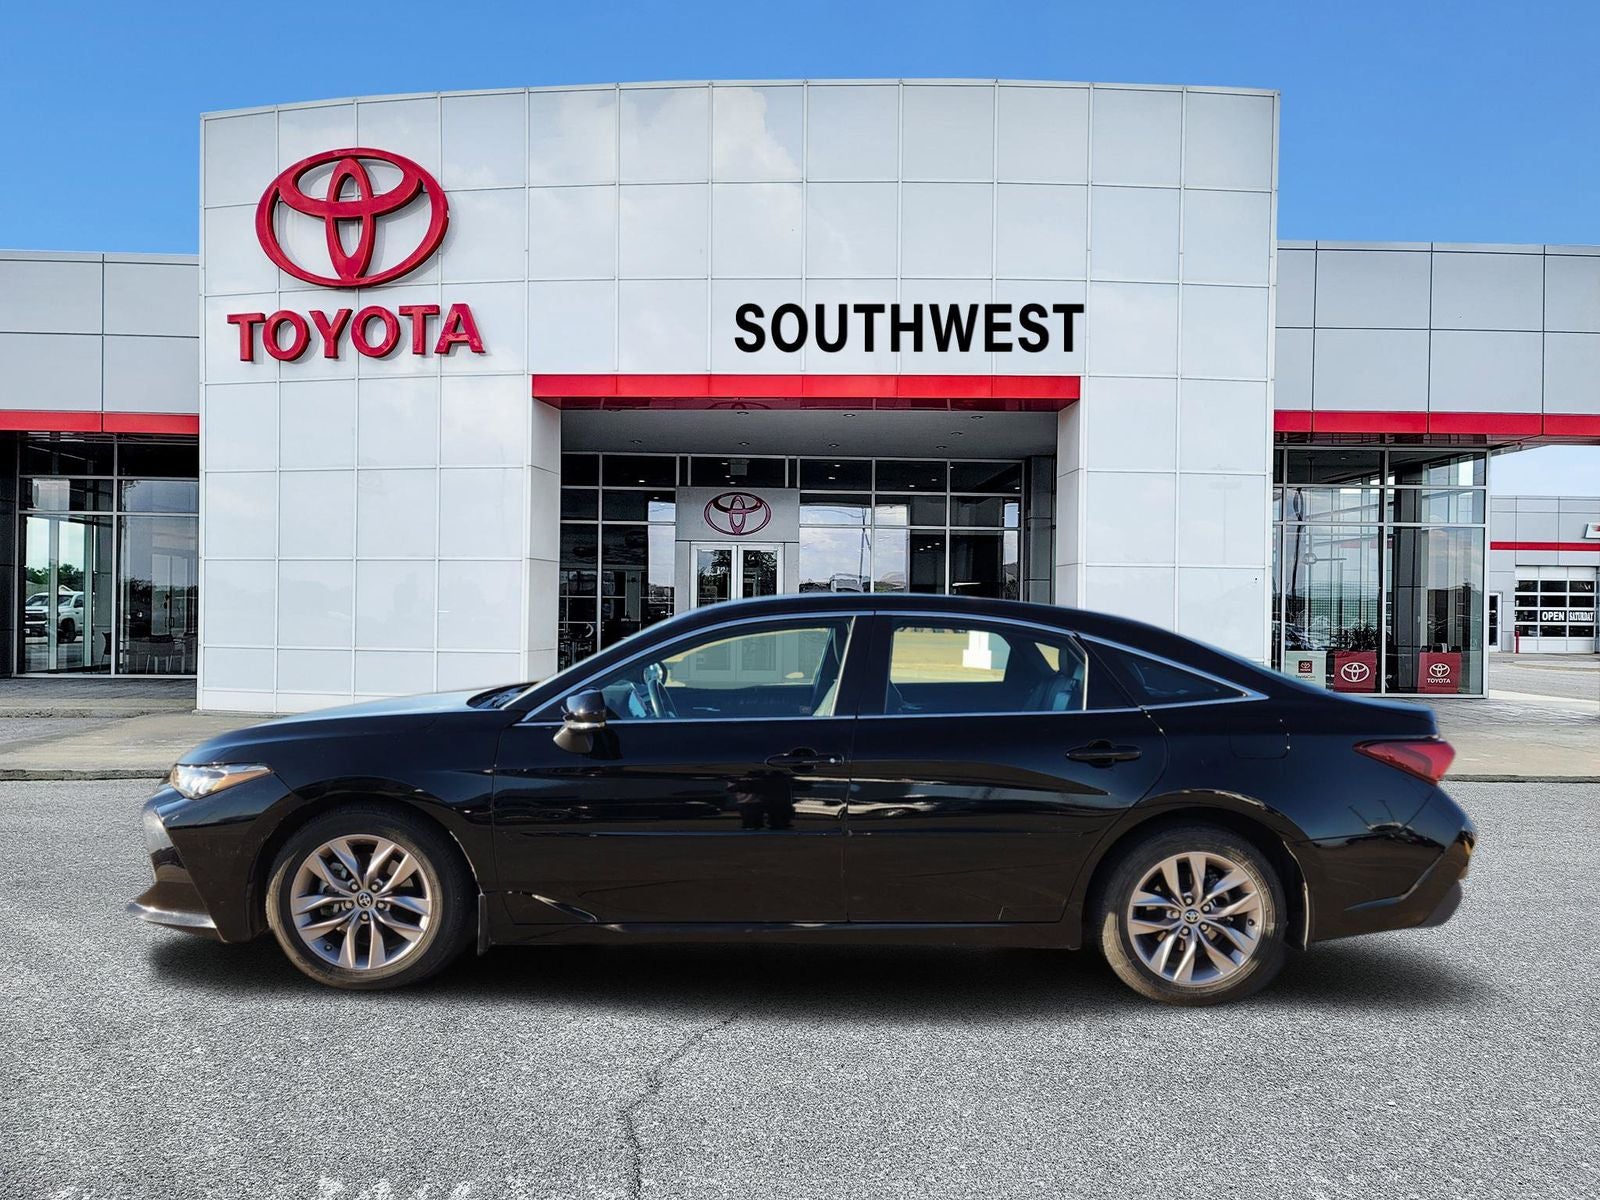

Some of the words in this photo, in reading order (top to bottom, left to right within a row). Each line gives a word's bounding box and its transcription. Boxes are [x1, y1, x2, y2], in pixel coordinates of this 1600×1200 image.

[227, 303, 486, 362] TOYOTA
[734, 303, 1084, 353] SOUTHWEST
[1541, 611, 1565, 621] OPEN
